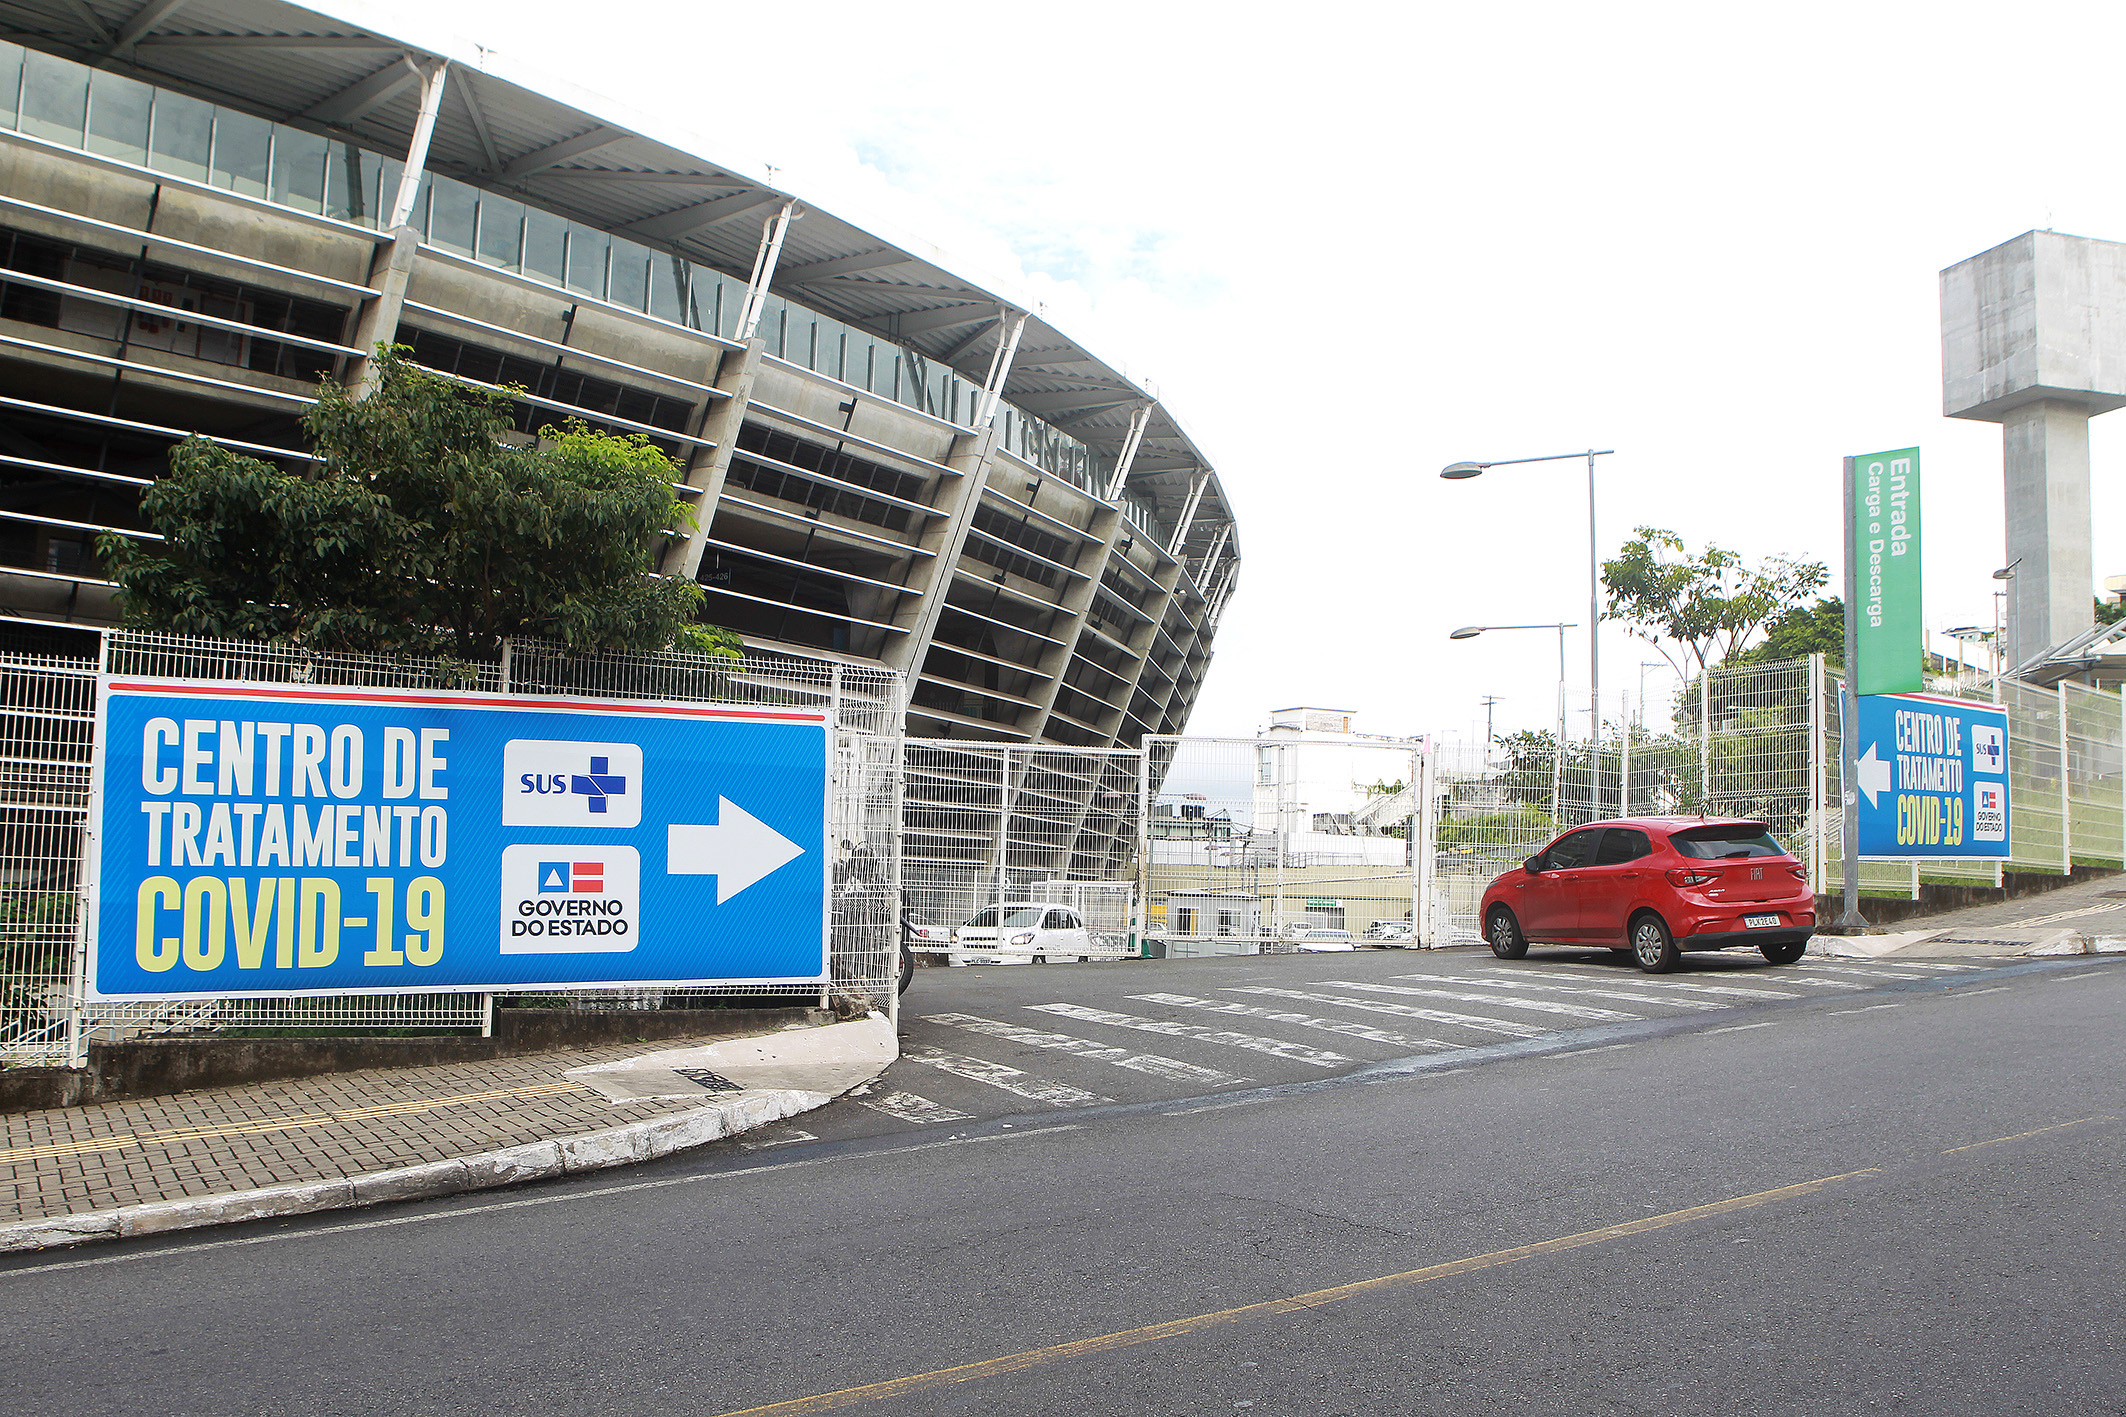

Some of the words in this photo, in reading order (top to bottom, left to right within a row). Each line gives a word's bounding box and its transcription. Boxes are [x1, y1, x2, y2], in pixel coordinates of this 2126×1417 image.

[1865, 461, 1884, 517] Carga
[1890, 457, 1912, 557] Entrada
[1868, 521, 1881, 534] e
[1866, 538, 1885, 628] Descarga
[1895, 709, 1943, 755] CENTRO
[1945, 716, 1962, 757] DE
[1975, 743, 1987, 755] SUS
[142, 717, 364, 799] CENTRO
[382, 726, 450, 800] DE
[1896, 754, 1963, 793] TRATAMENTO
[520, 773, 567, 795] SUS
[141, 801, 447, 868] TRATAMENTO
[1897, 793, 1963, 846] COVID-19
[1976, 821, 1984, 832] DO
[1984, 822, 2003, 832] ESTADO
[1977, 811, 2002, 822] GOVERNO
[1750, 867, 1763, 881] FIAT
[135, 876, 446, 973] COVID-19
[512, 920, 545, 937] DO
[548, 919, 629, 937] ESTADO
[518, 900, 623, 917] GOVERNO
